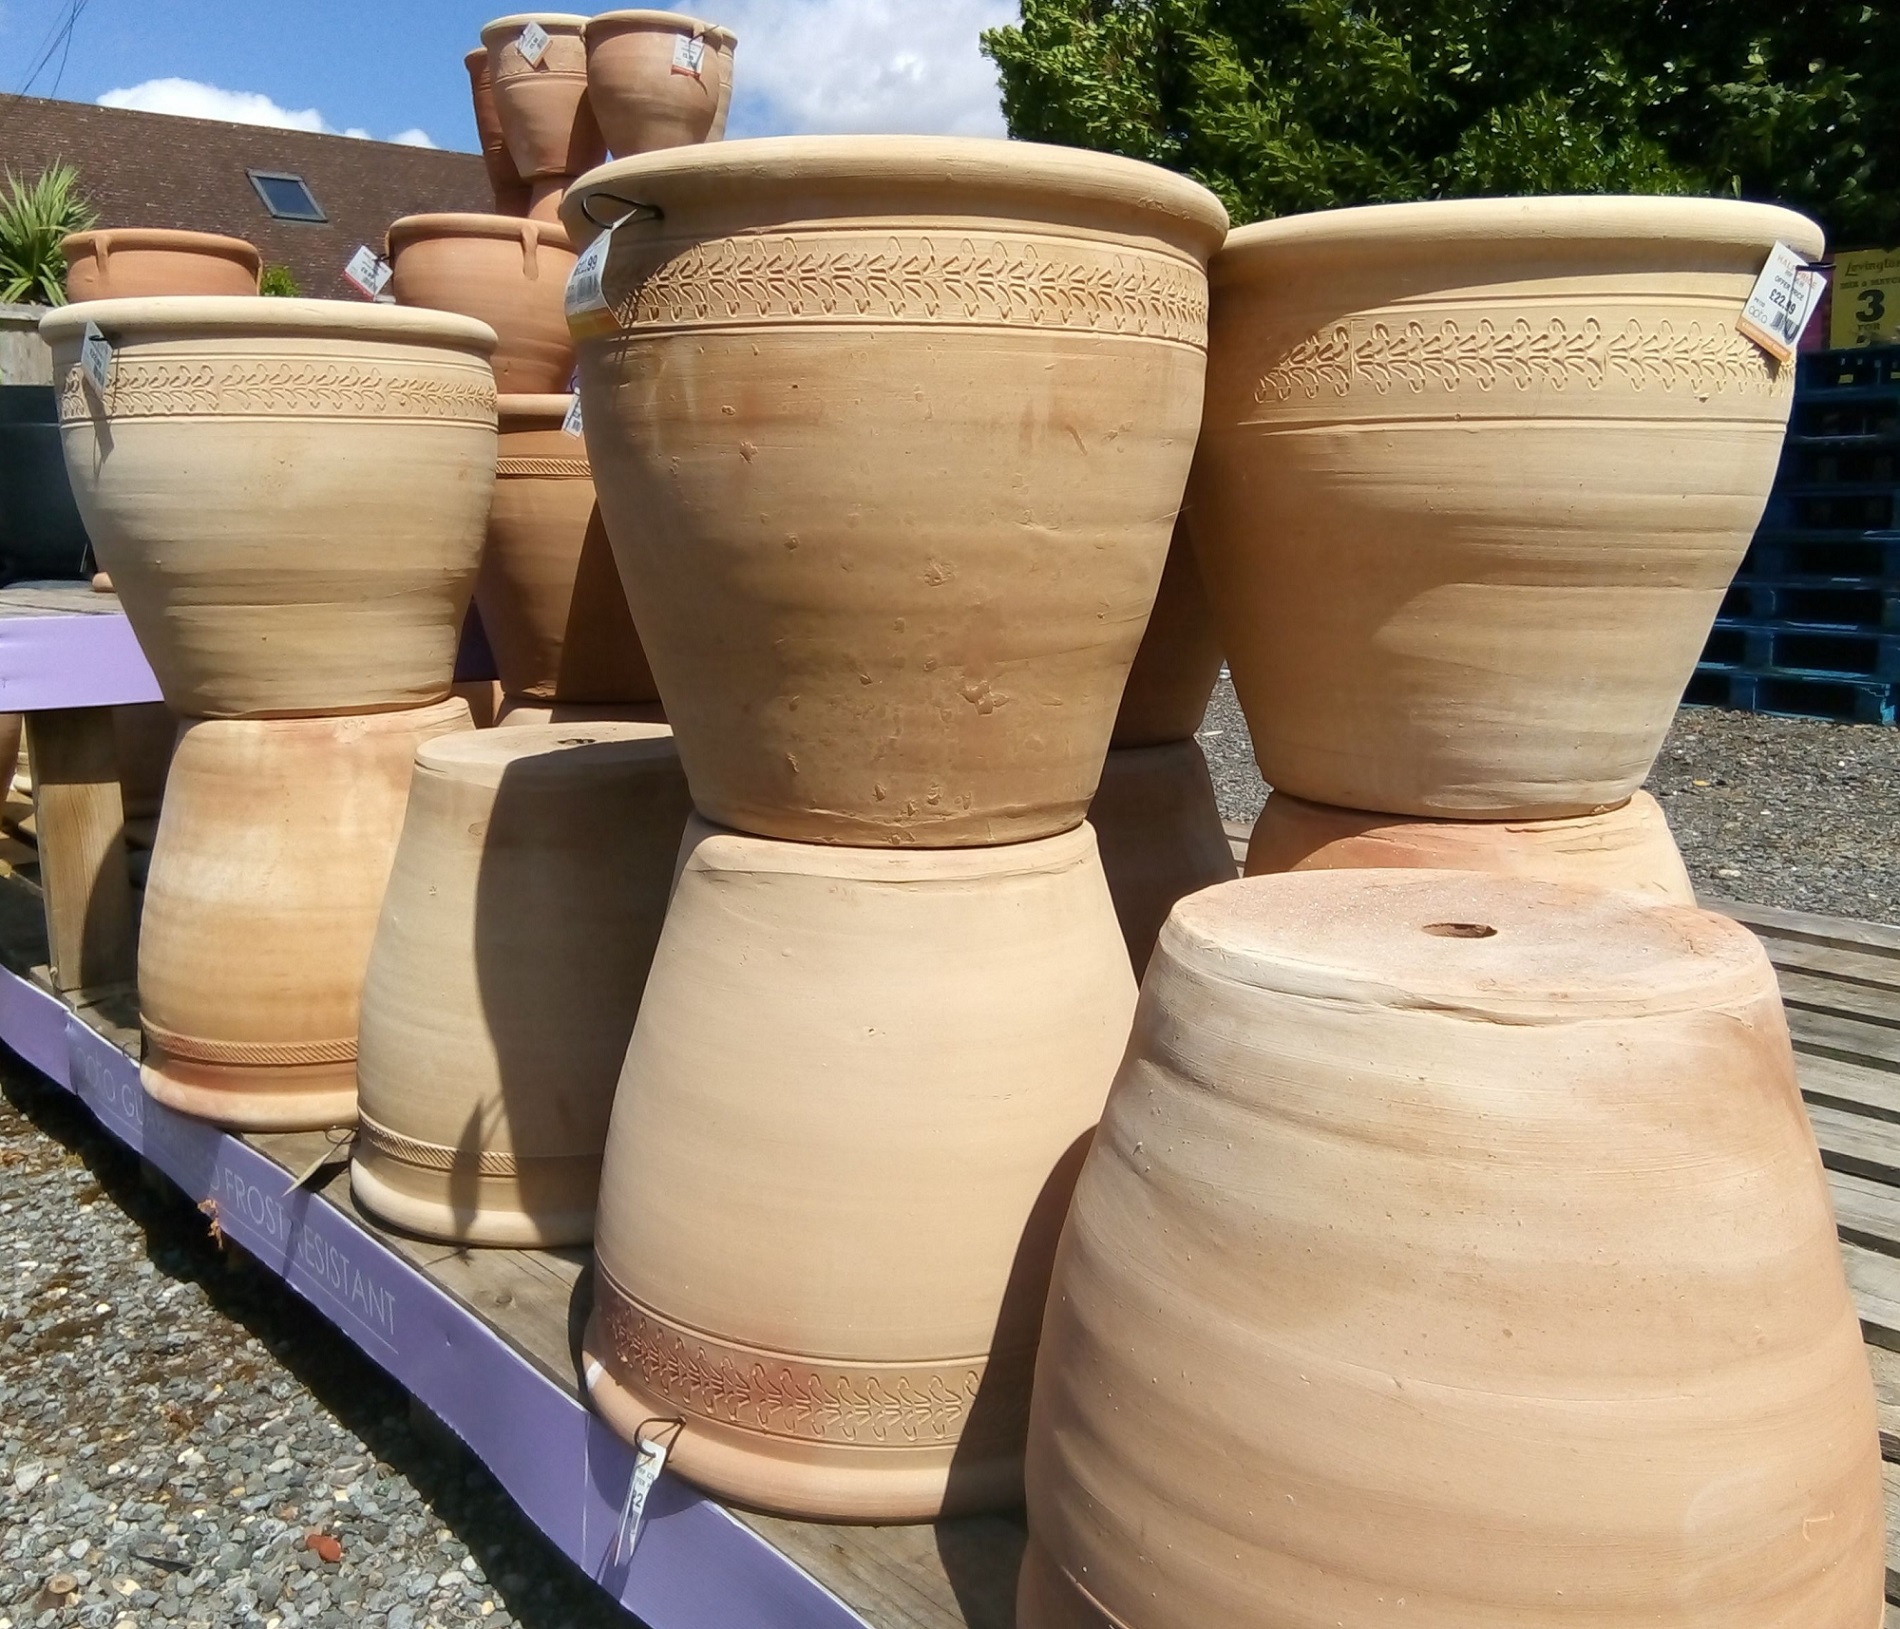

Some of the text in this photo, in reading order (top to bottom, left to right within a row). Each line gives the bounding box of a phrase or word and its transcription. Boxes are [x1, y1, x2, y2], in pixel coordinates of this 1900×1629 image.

[1774, 274, 1791, 291] OFFER
[1769, 288, 1796, 315] £22.99
[1856, 289, 1885, 322] 3
[1858, 322, 1881, 331] FOR
[224, 1168, 284, 1241] FROST
